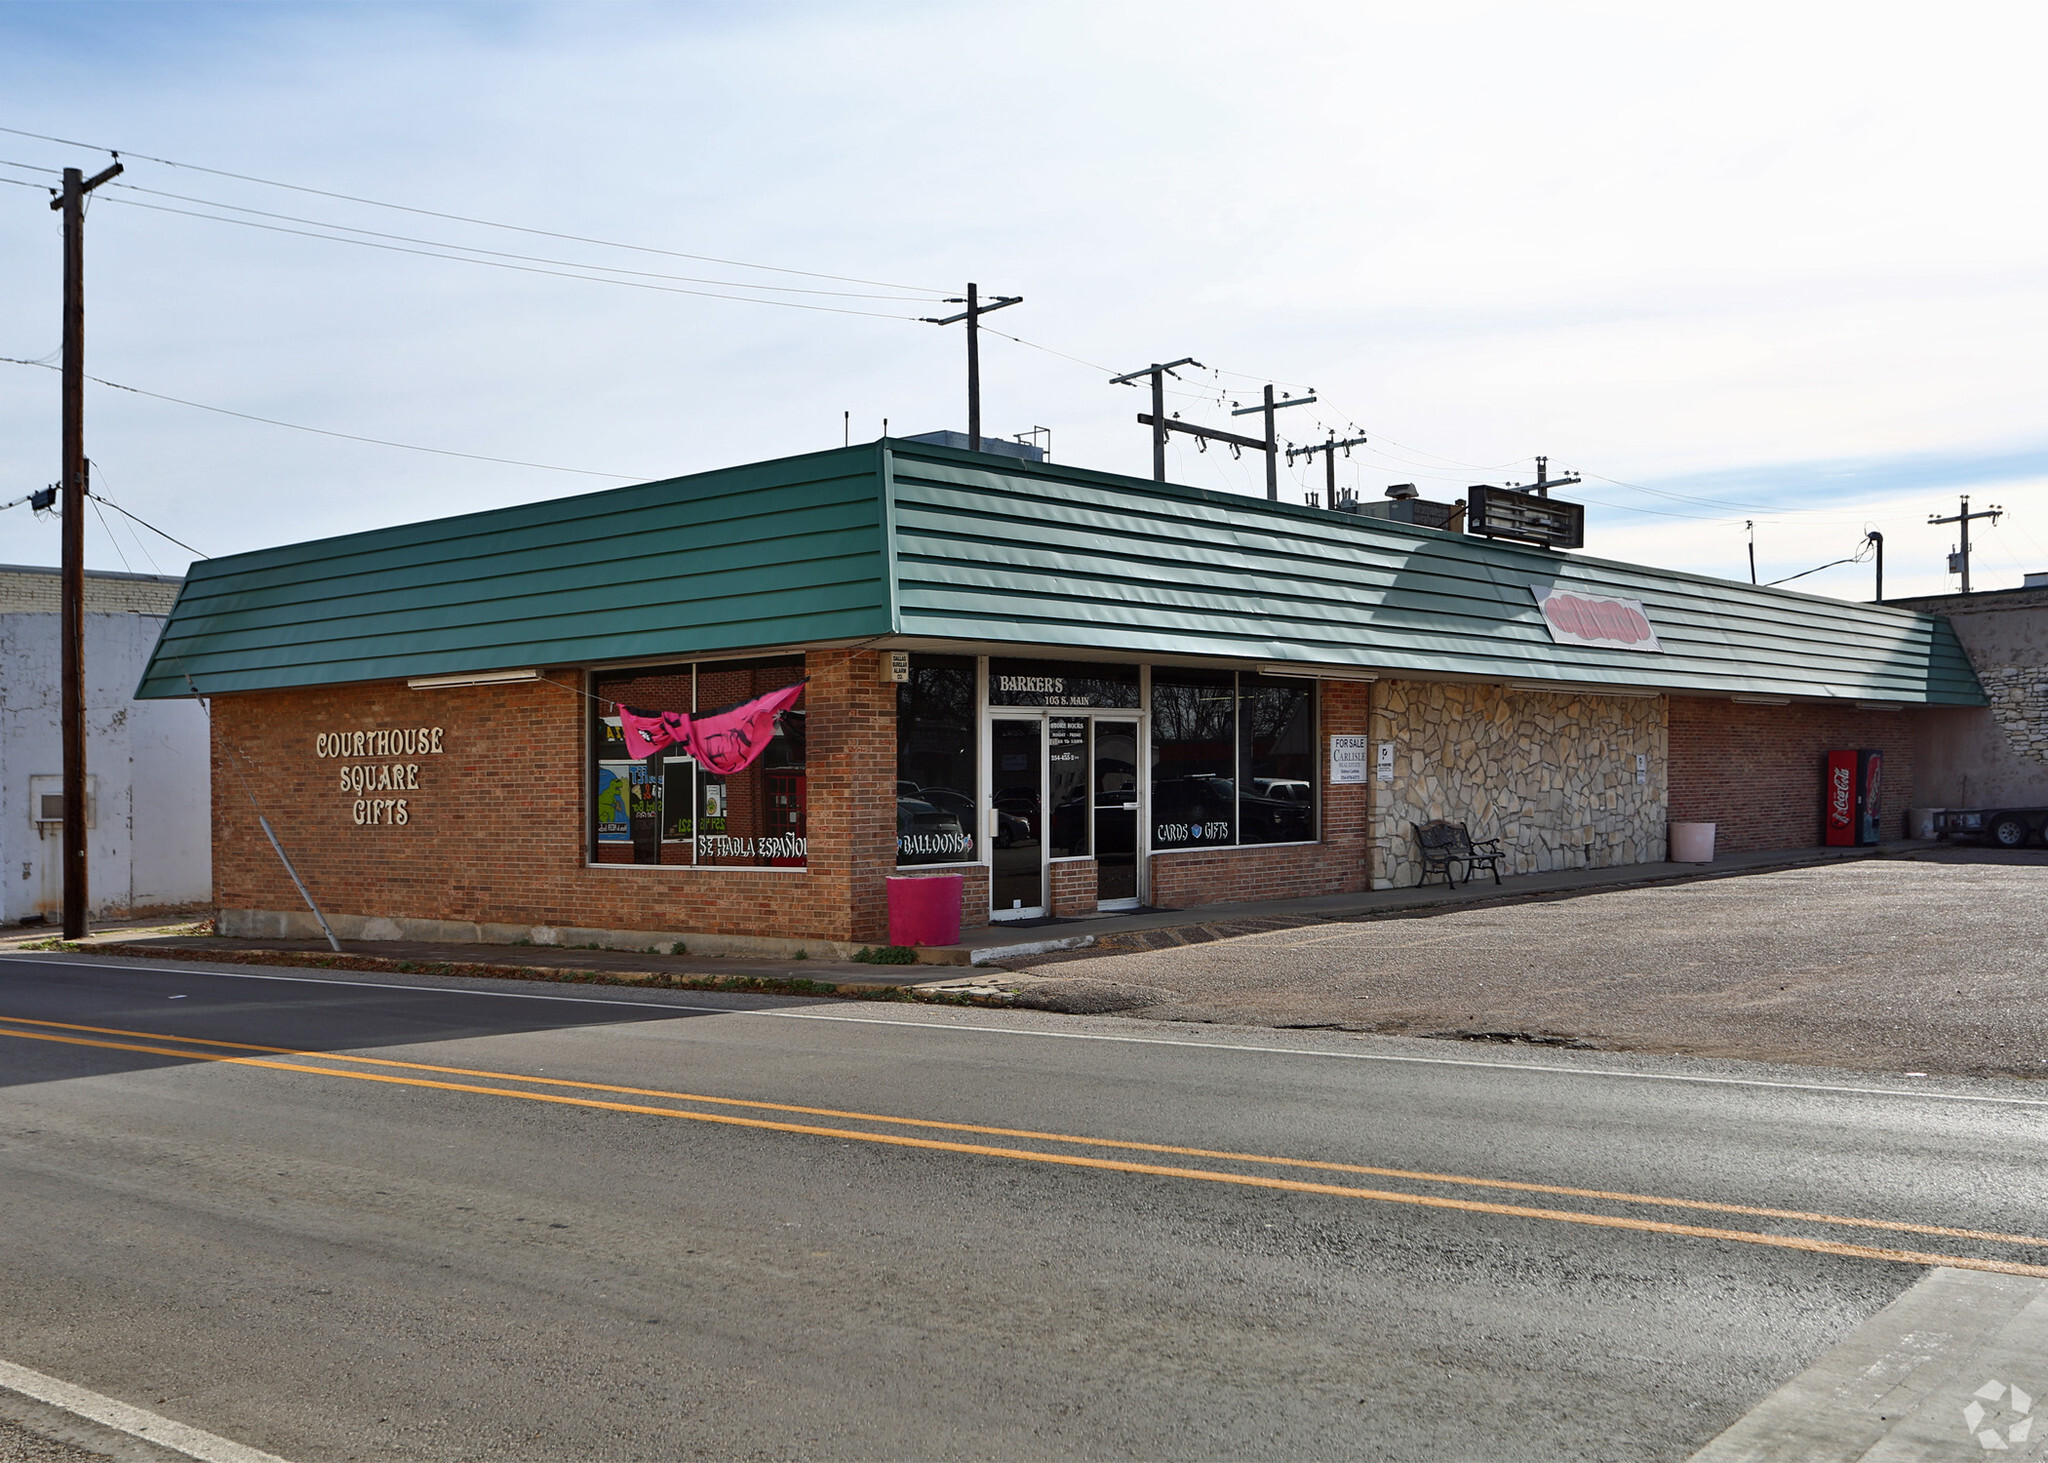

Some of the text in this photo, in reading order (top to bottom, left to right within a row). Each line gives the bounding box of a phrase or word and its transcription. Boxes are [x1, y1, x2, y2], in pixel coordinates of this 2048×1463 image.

[1061, 696, 1069, 705] S.
[1070, 696, 1089, 705] MAIN
[317, 727, 443, 758] COURTHOUSE
[1336, 738, 1365, 748] FOR SALE
[340, 763, 420, 796] SQUARE
[353, 799, 409, 826] GIFTS
[903, 832, 964, 856] BALLOONS
[1157, 821, 1229, 842] CARDS GIFTS
[700, 832, 808, 859] SE HABLA ESPAÑOL
